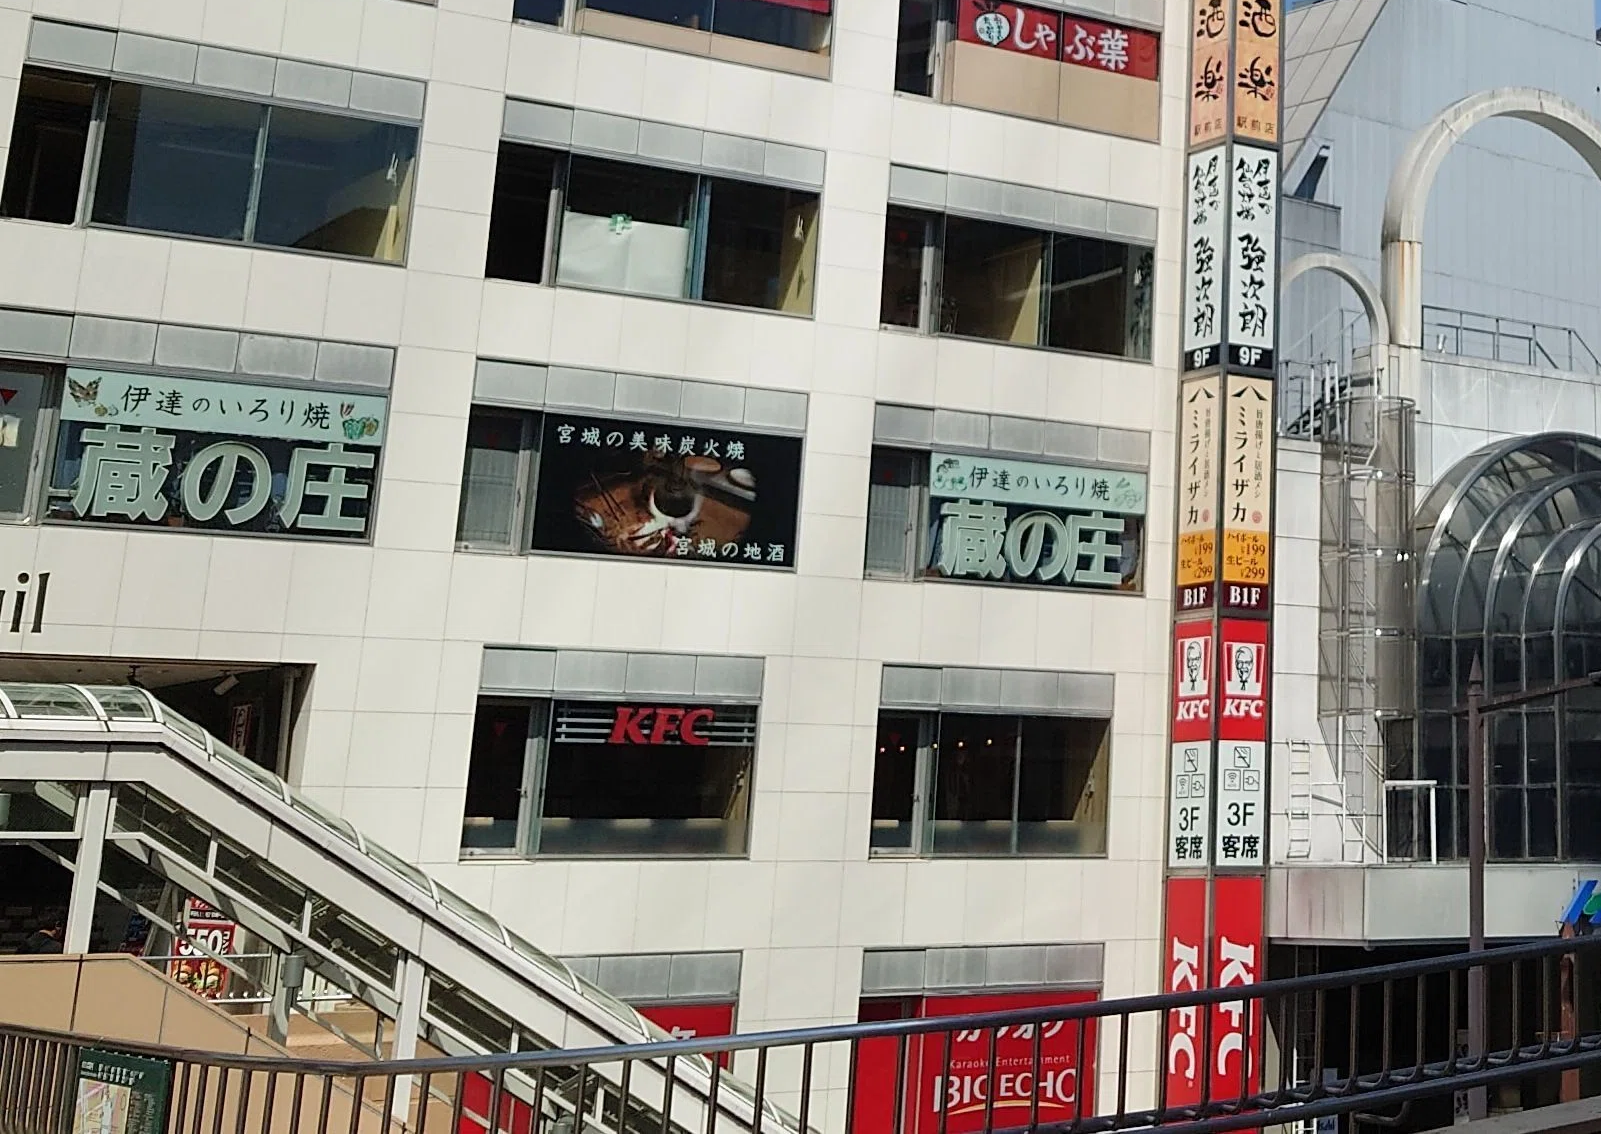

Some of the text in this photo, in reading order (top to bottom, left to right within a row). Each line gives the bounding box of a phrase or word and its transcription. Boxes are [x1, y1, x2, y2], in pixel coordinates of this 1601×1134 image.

[1012, 8, 1130, 72] しゃぶ葉
[1236, 115, 1276, 135] 駅前店
[1193, 348, 1212, 367] 9F
[1238, 346, 1263, 366] 9F
[121, 383, 331, 430] 伊達のいろり焼
[556, 423, 746, 462] 宮城の美味炭火焼
[72, 424, 375, 532] 蔵の庄
[1187, 409, 1201, 526] ミライザカ
[1231, 406, 1250, 524] ミライザカ
[968, 465, 1111, 502] 伊達のいろり焼
[674, 536, 786, 563] 宮城の地酒
[938, 499, 1125, 585] 蔵の庄
[1227, 533, 1260, 544] ハイボール
[1226, 555, 1260, 566] 生ビール
[1176, 698, 1211, 720] KFC
[1222, 698, 1265, 718] KFC
[607, 706, 716, 746] KFC
[1178, 806, 1201, 832] 3F
[1226, 802, 1256, 827] 3F
[1175, 835, 1203, 860] 客席
[1221, 834, 1260, 859] 客席
